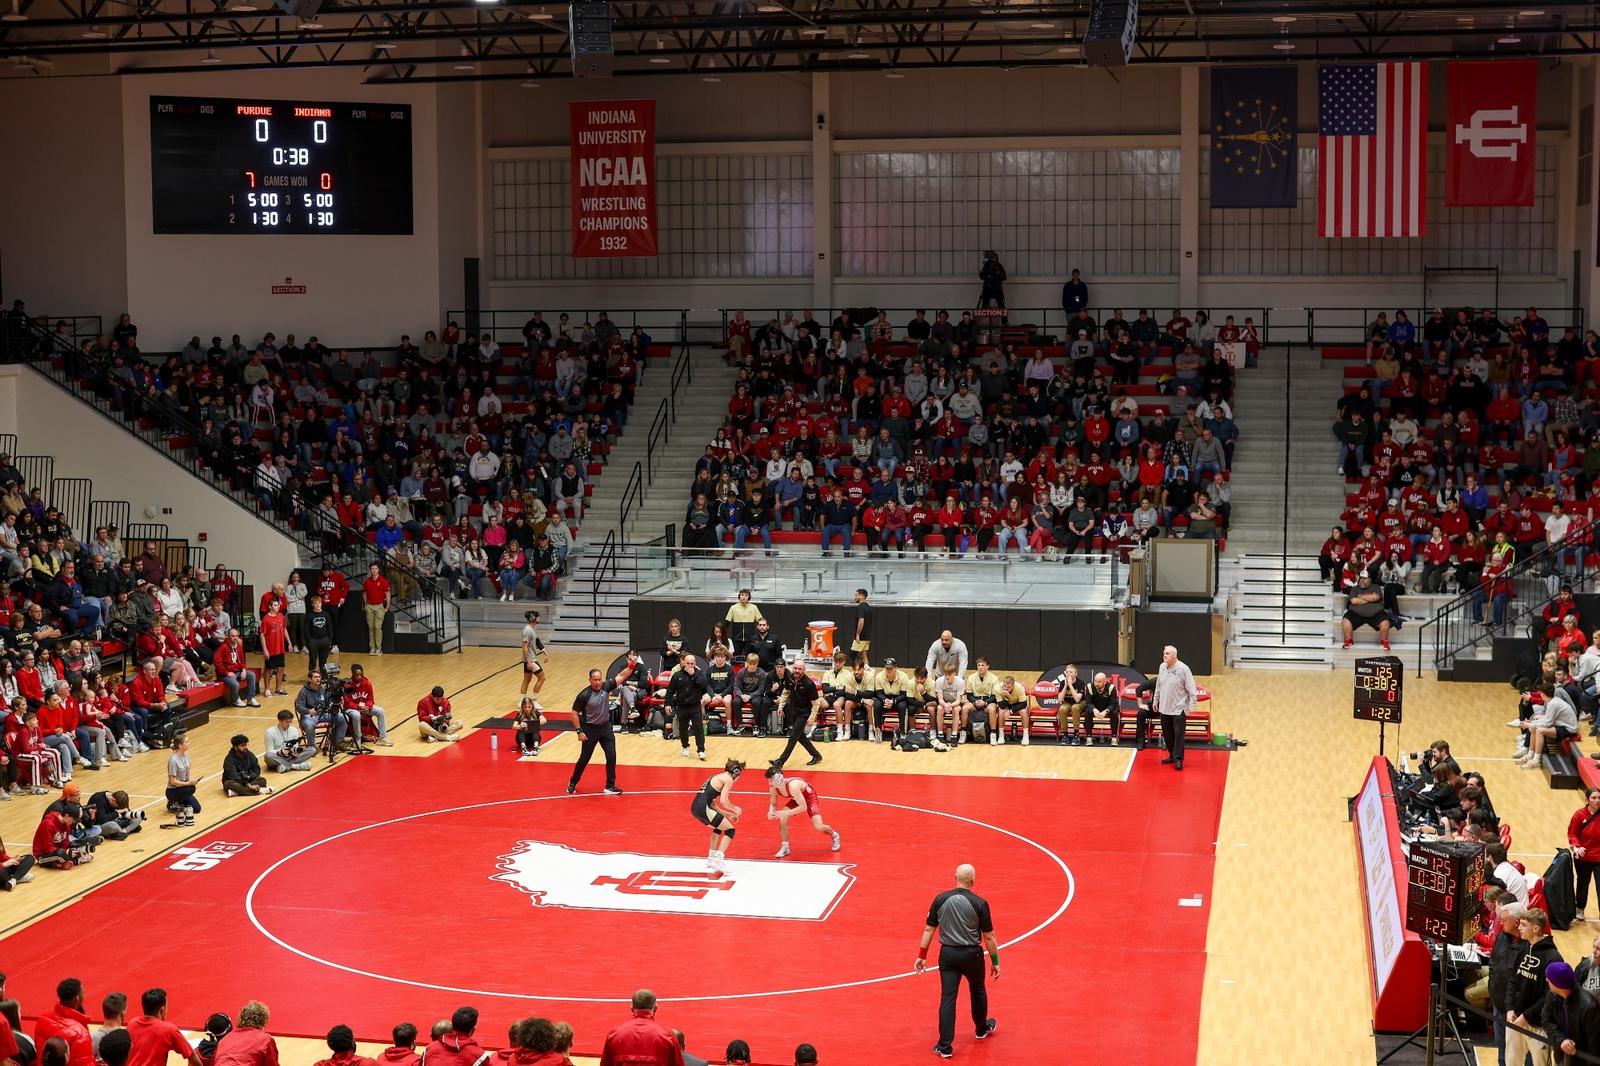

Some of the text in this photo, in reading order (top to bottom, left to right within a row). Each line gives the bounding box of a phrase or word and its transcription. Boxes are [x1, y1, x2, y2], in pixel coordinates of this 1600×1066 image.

[157, 104, 173, 112] PLYR
[237, 106, 272, 116] PURDUE
[294, 108, 331, 117] INDIANA
[588, 110, 636, 125] INDIANA
[256, 119, 268, 142] 0
[314, 121, 327, 143] 0
[579, 130, 647, 145] UNIVERSITY
[273, 148, 308, 165] 0:38
[580, 157, 648, 187] NCAA
[245, 172, 254, 188] 7
[264, 176, 308, 187] GAMES WON
[321, 173, 331, 190] 0
[581, 197, 646, 211] WRESTLING
[580, 216, 648, 231] CHAMPIONS
[600, 236, 627, 250] 1932
[973, 309, 1002, 317] SECTION
[814, 632, 824, 643] G
[1376, 667, 1393, 678] 125
[1364, 676, 1397, 691] 0:38 2
[1388, 690, 1395, 702] 0
[1371, 707, 1391, 720] 1:22
[1411, 854, 1451, 877] MATCH 125
[1418, 869, 1444, 891] 0:38
[1448, 880, 1456, 895] 2
[1445, 895, 1453, 912] 0
[1425, 917, 1448, 938] 1:22
